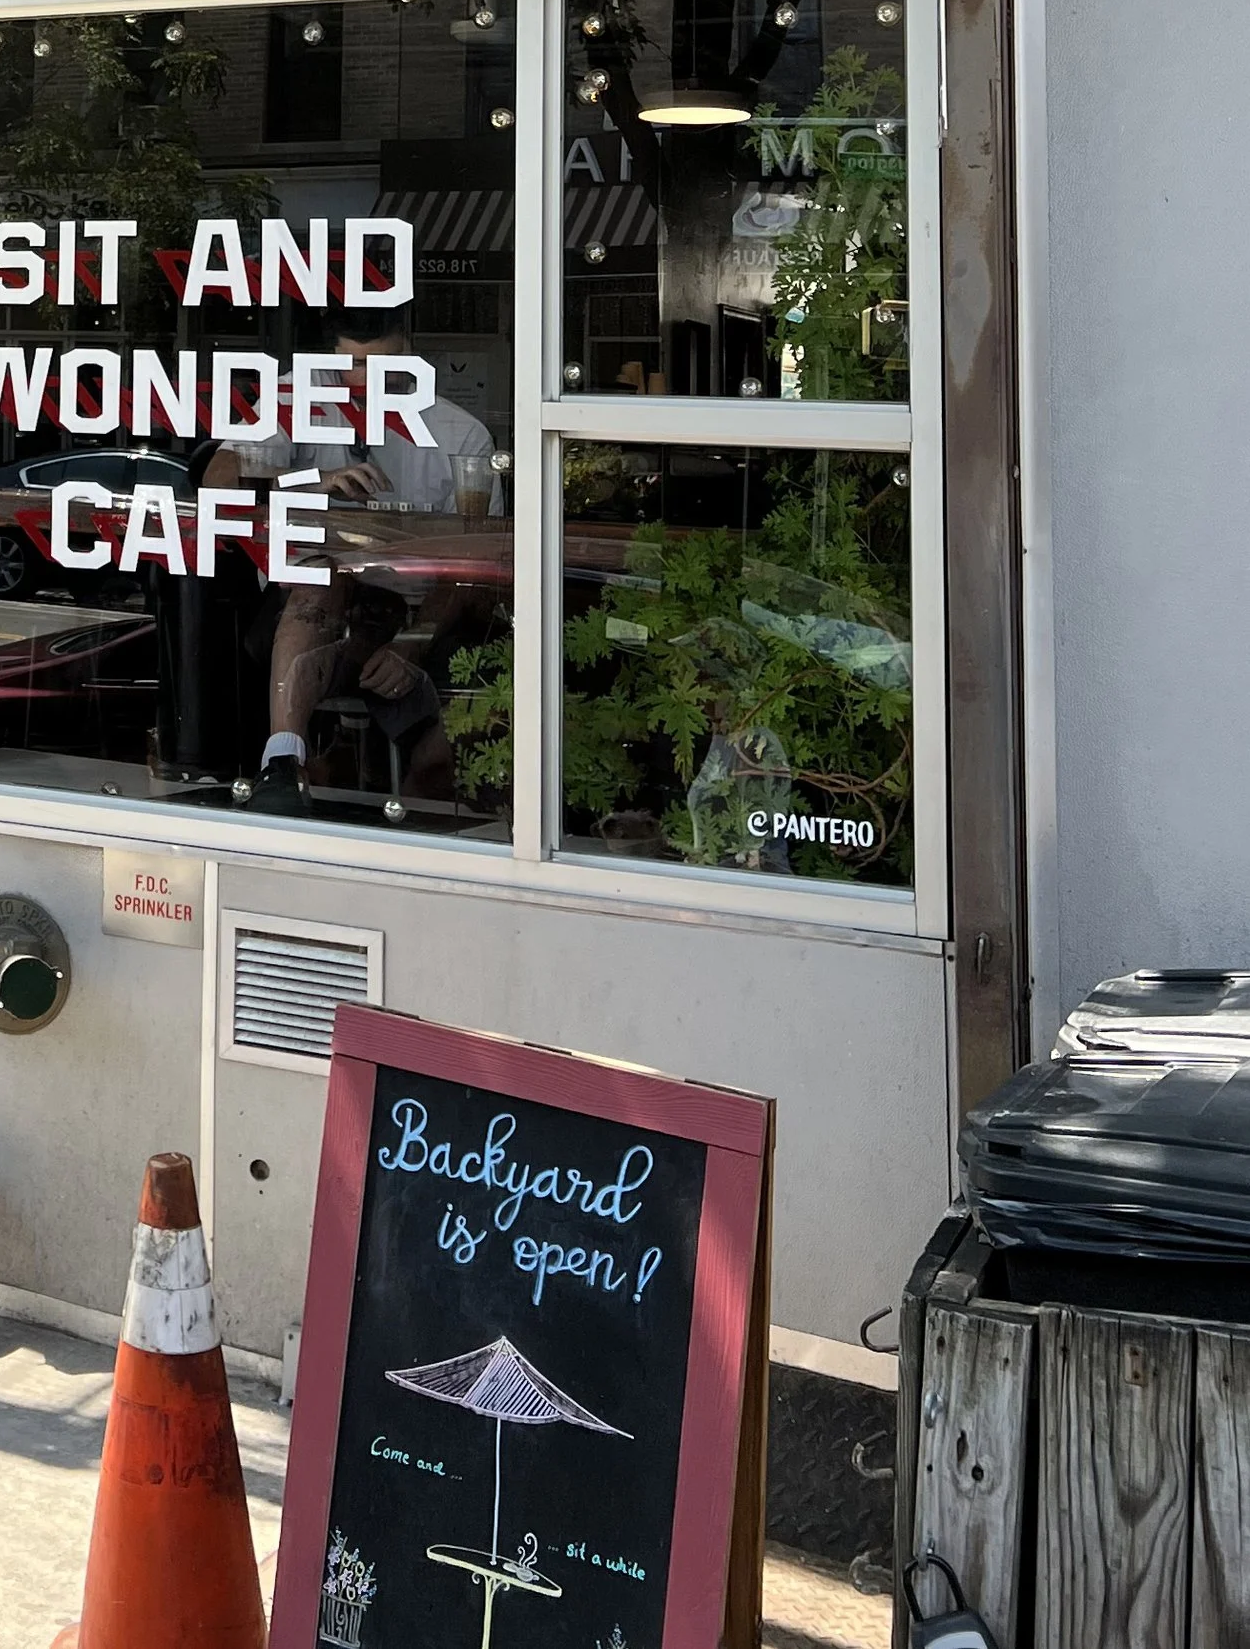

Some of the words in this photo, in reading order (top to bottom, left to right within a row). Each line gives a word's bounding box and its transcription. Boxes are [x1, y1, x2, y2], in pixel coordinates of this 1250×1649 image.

[182, 217, 415, 308] AND
[50, 468, 332, 587] CAFÉ
[114, 894, 192, 921] SPRINKLER
[135, 874, 172, 895] F.D.C.
[377, 1098, 655, 1231] Backyard
[437, 1203, 487, 1265] is
[370, 1436, 410, 1465] Come
[566, 1542, 586, 1561] sit
[591, 1552, 602, 1567] a
[605, 1555, 646, 1582] while
